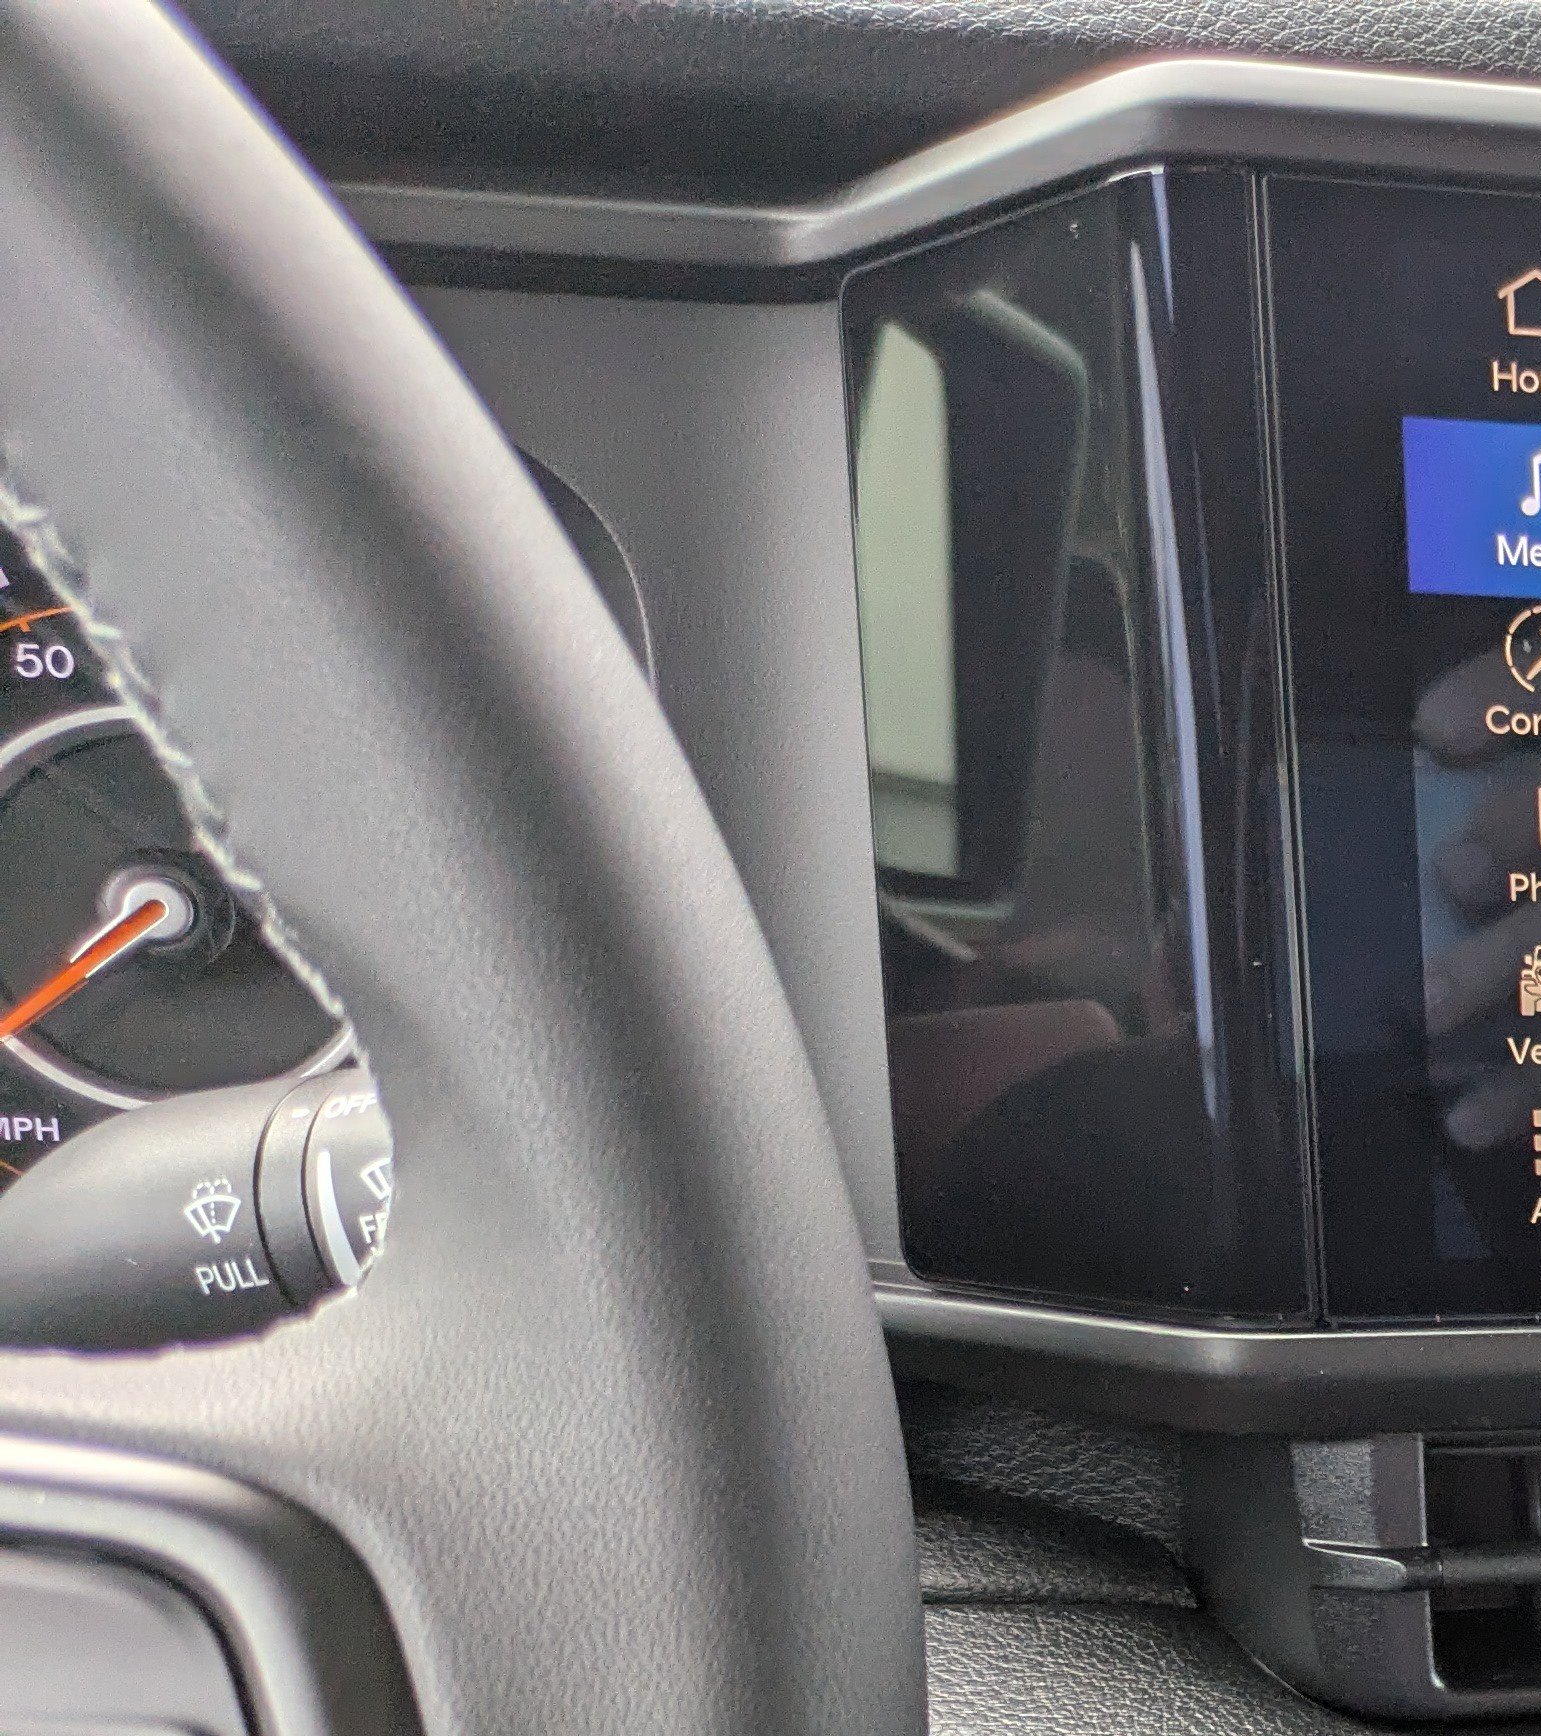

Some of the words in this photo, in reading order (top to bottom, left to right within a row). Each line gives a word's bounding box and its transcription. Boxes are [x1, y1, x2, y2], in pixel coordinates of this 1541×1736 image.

[15, 643, 75, 679] 50
[325, 1092, 378, 1119] OFF
[196, 1257, 270, 1297] PULL
